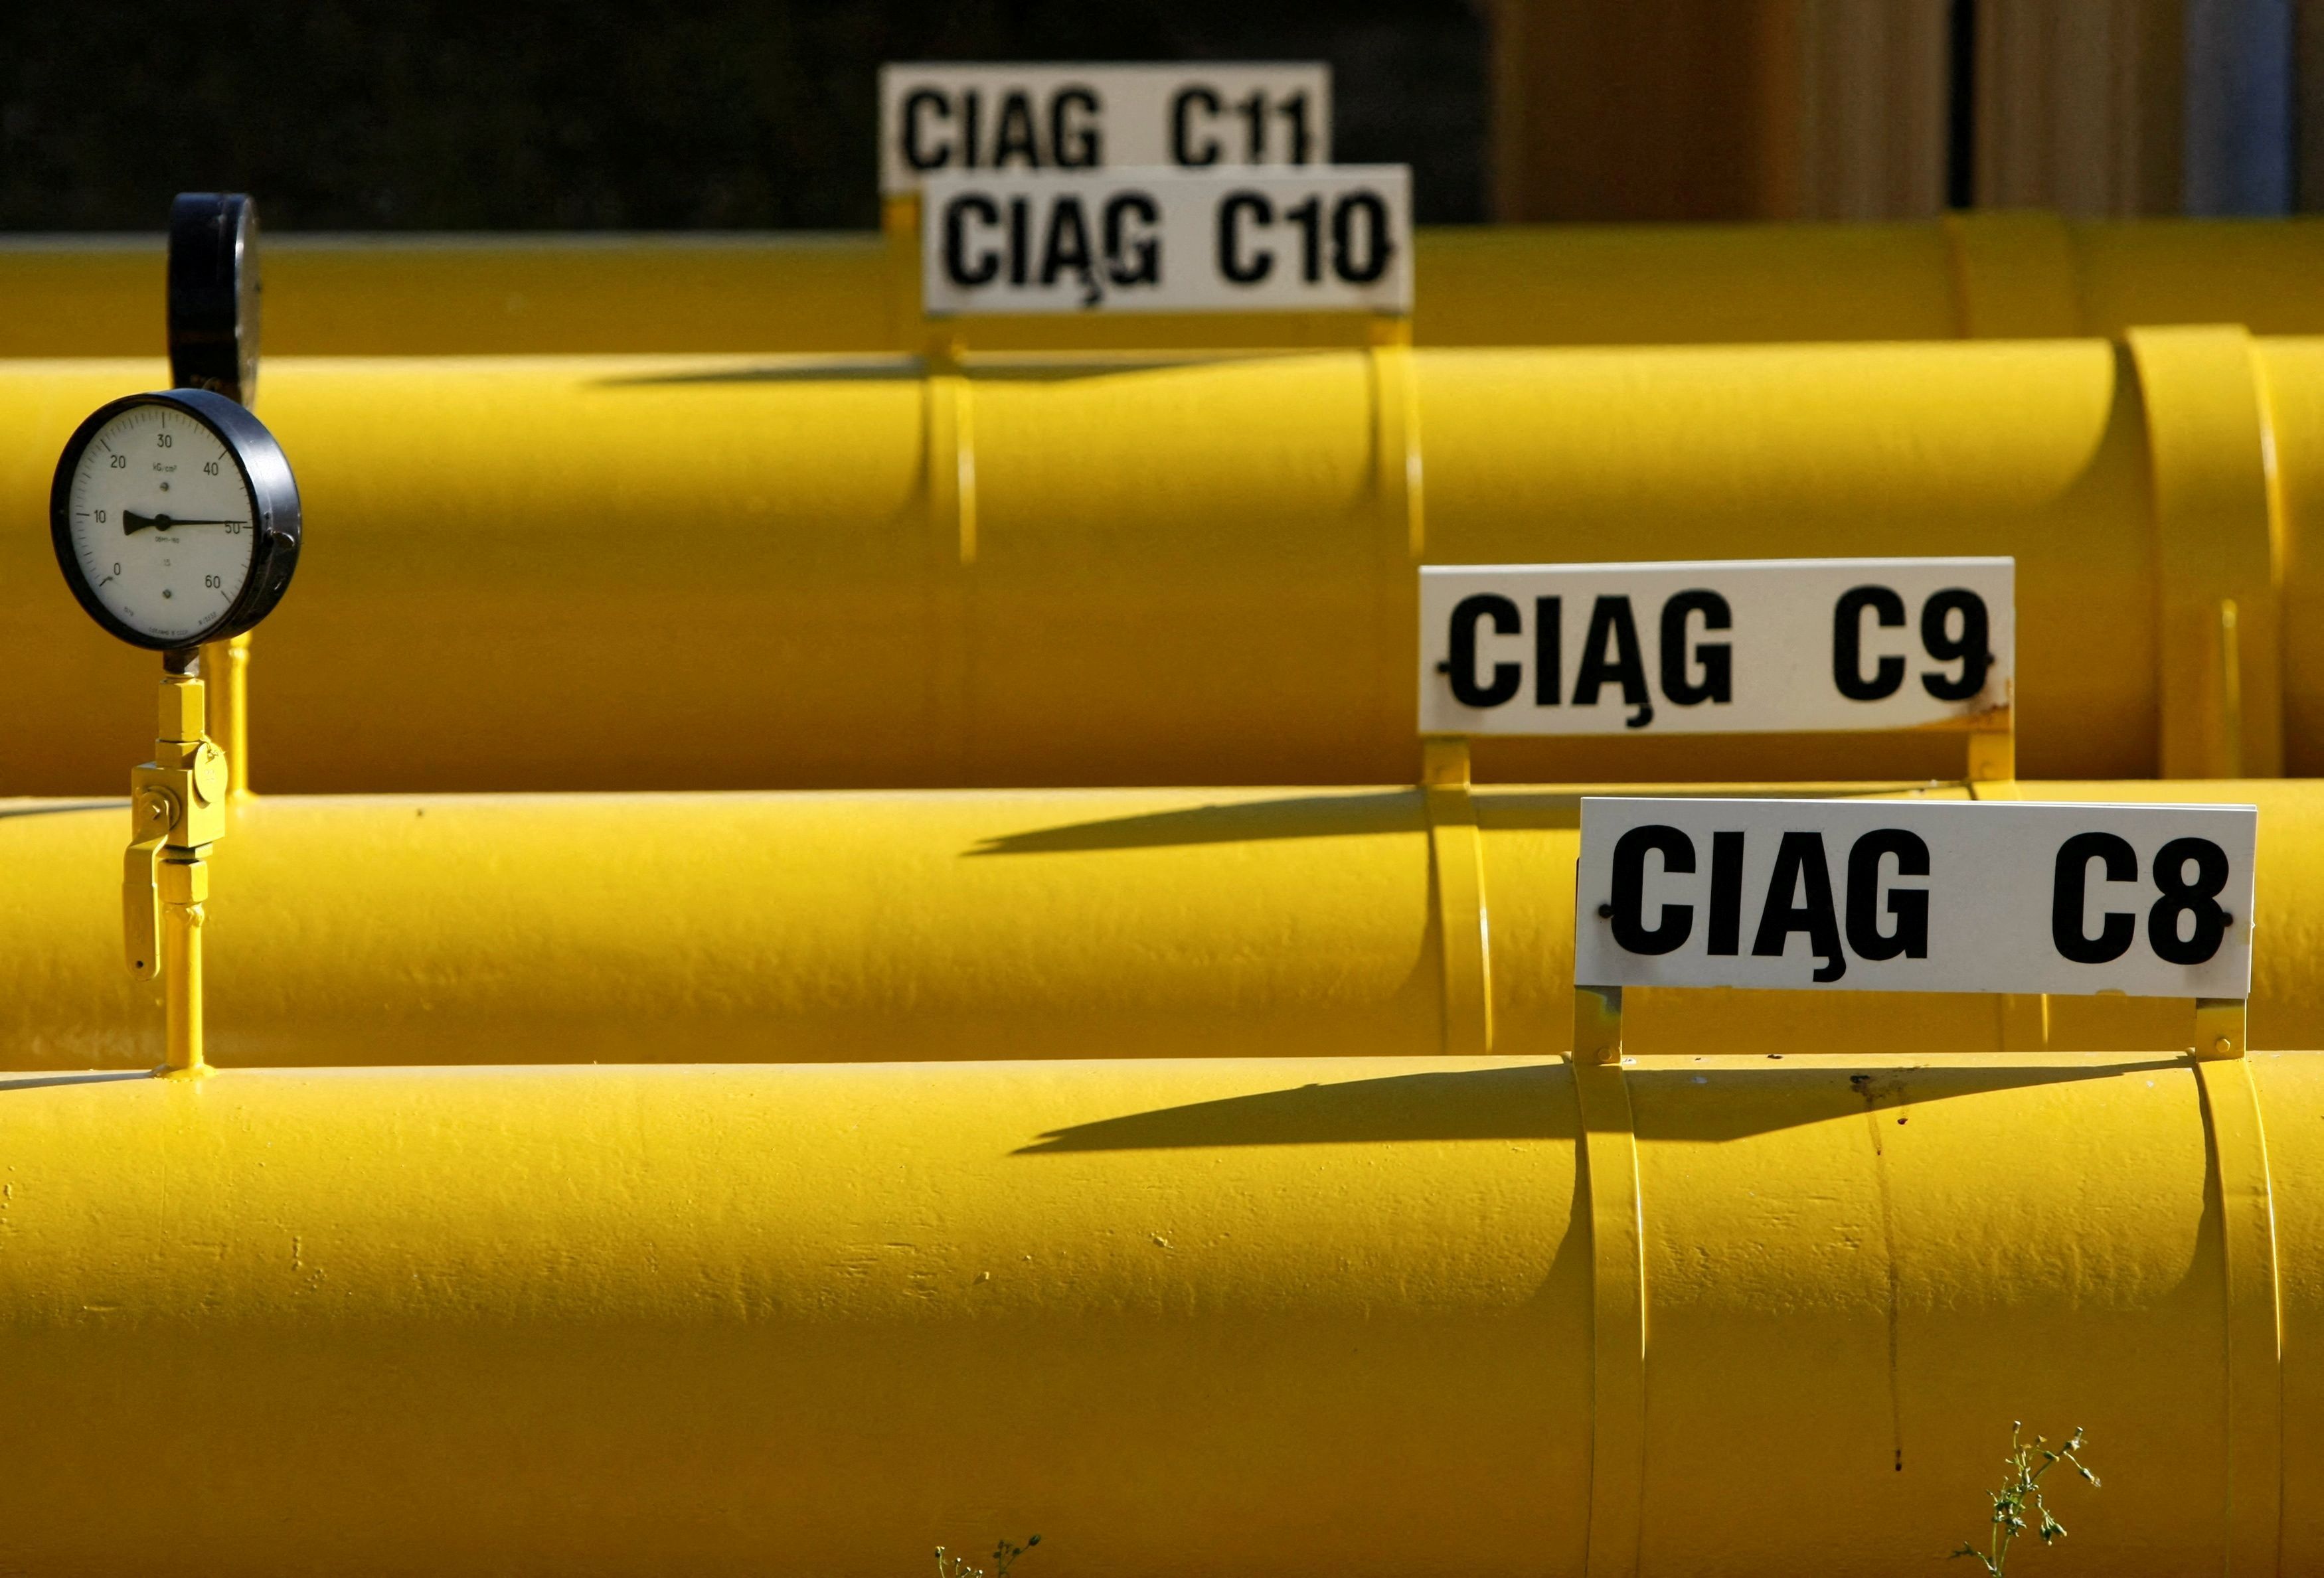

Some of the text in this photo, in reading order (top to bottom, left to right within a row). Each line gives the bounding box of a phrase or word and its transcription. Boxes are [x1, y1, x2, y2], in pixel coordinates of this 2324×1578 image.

[1171, 86, 1309, 166] C11
[944, 190, 1390, 307] CIĄG C10
[157, 434, 173, 448] 30
[110, 455, 126, 469] 20
[203, 461, 219, 476] 40
[94, 509, 106, 523] 10
[224, 521, 240, 534] 50
[113, 562, 122, 576] 0
[205, 575, 220, 589] 60
[1449, 585, 1989, 728] CIĄG C9
[1610, 825, 2230, 983] CIĄG C8
